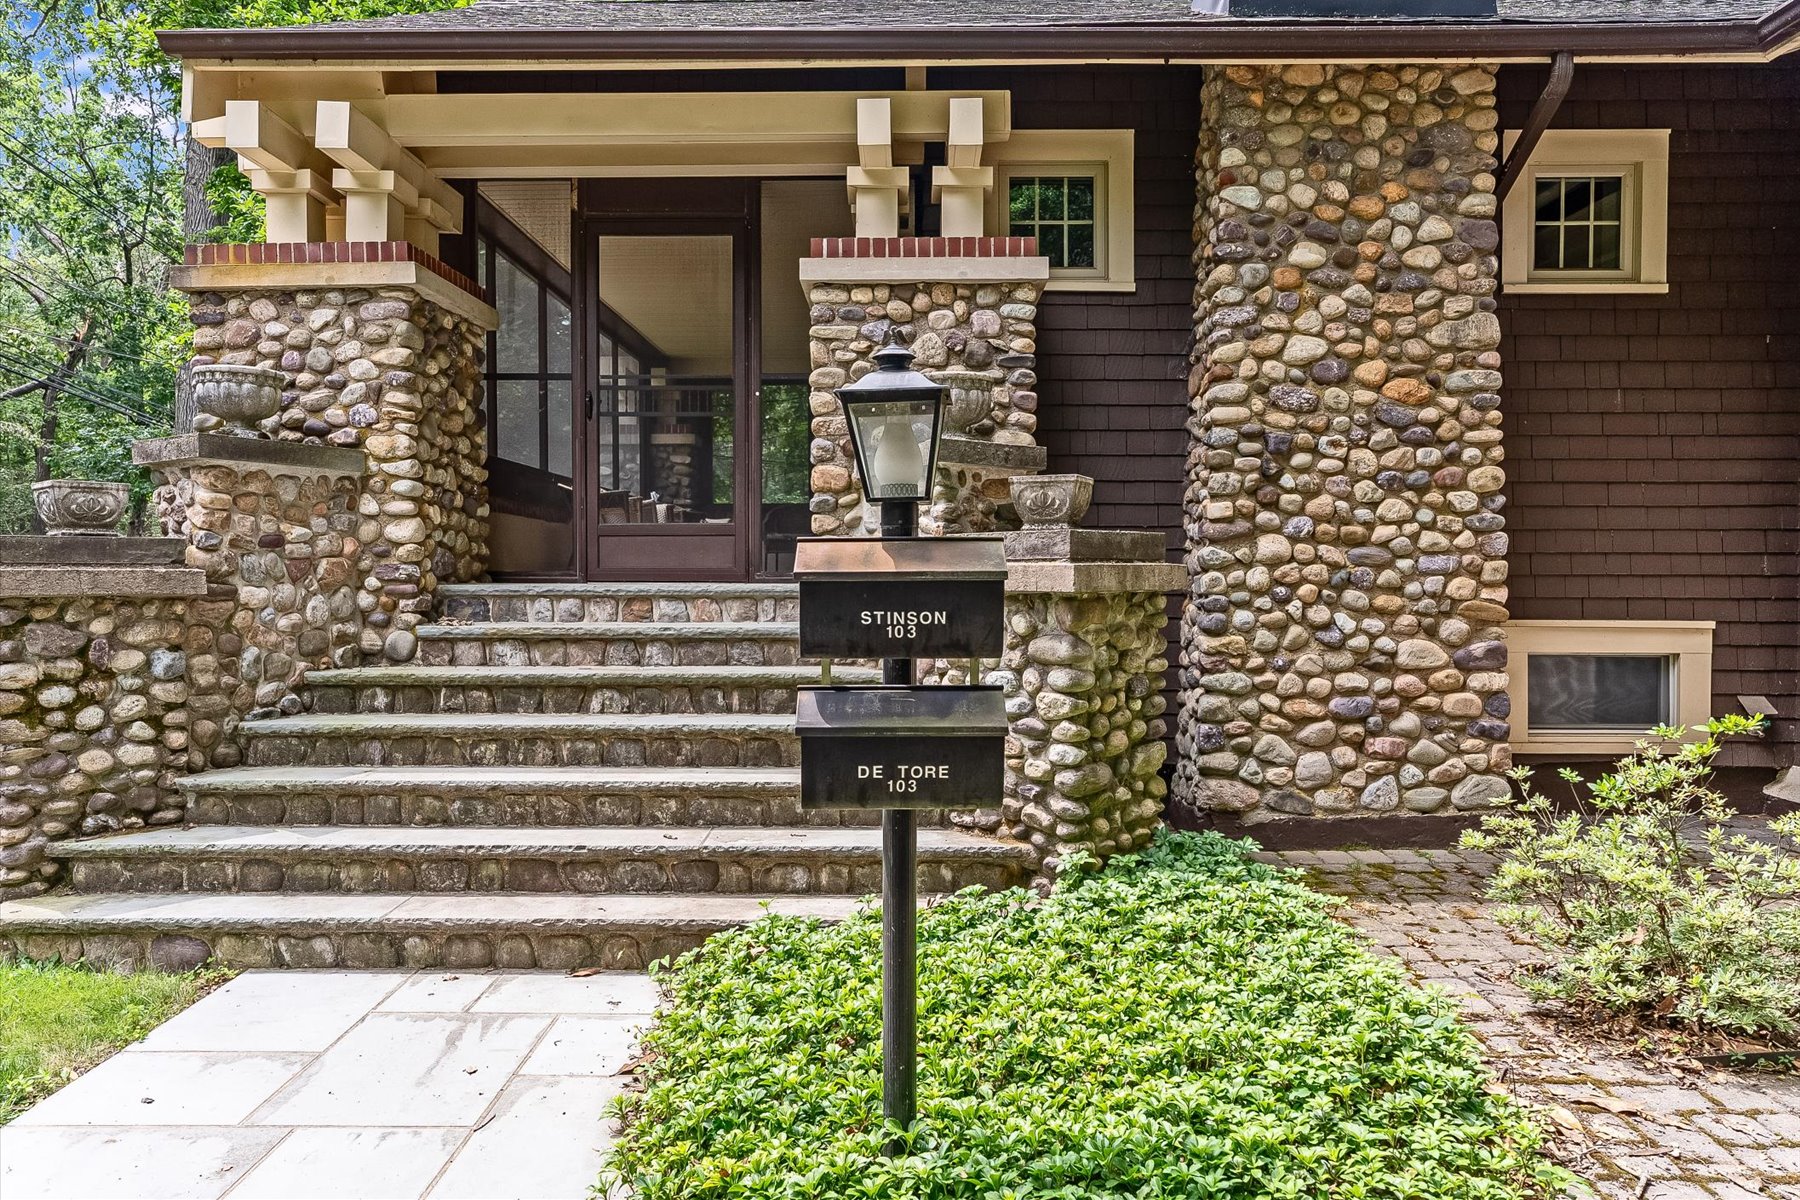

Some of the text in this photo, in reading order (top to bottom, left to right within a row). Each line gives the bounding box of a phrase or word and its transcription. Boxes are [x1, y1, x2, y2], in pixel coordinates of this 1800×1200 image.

[860, 611, 947, 625] STINSON
[886, 625, 917, 638] 103
[857, 765, 949, 779] DE TORE
[886, 779, 917, 792] 103
